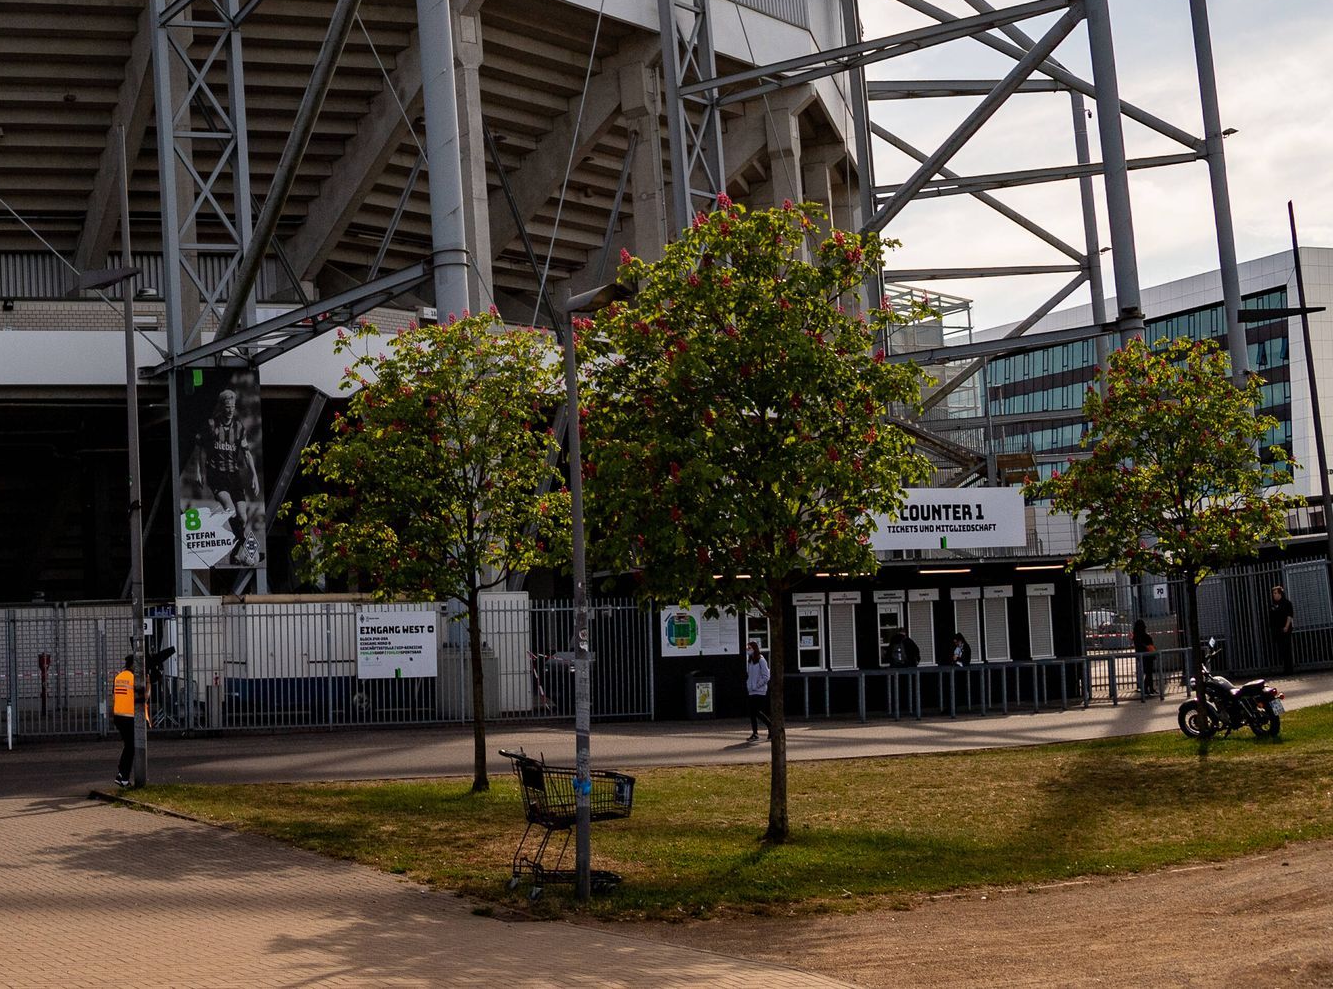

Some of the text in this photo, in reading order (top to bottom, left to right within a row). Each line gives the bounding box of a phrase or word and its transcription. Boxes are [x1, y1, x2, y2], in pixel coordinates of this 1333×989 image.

[900, 504, 984, 521] COUNTER 1
[185, 508, 201, 530] 8
[887, 523, 997, 533] TICKETS UND MITGLIEDSCHAFT
[186, 531, 216, 540] STEFAN
[186, 539, 232, 549] EFFENBERG
[360, 625, 425, 634] EINGANG WEST
